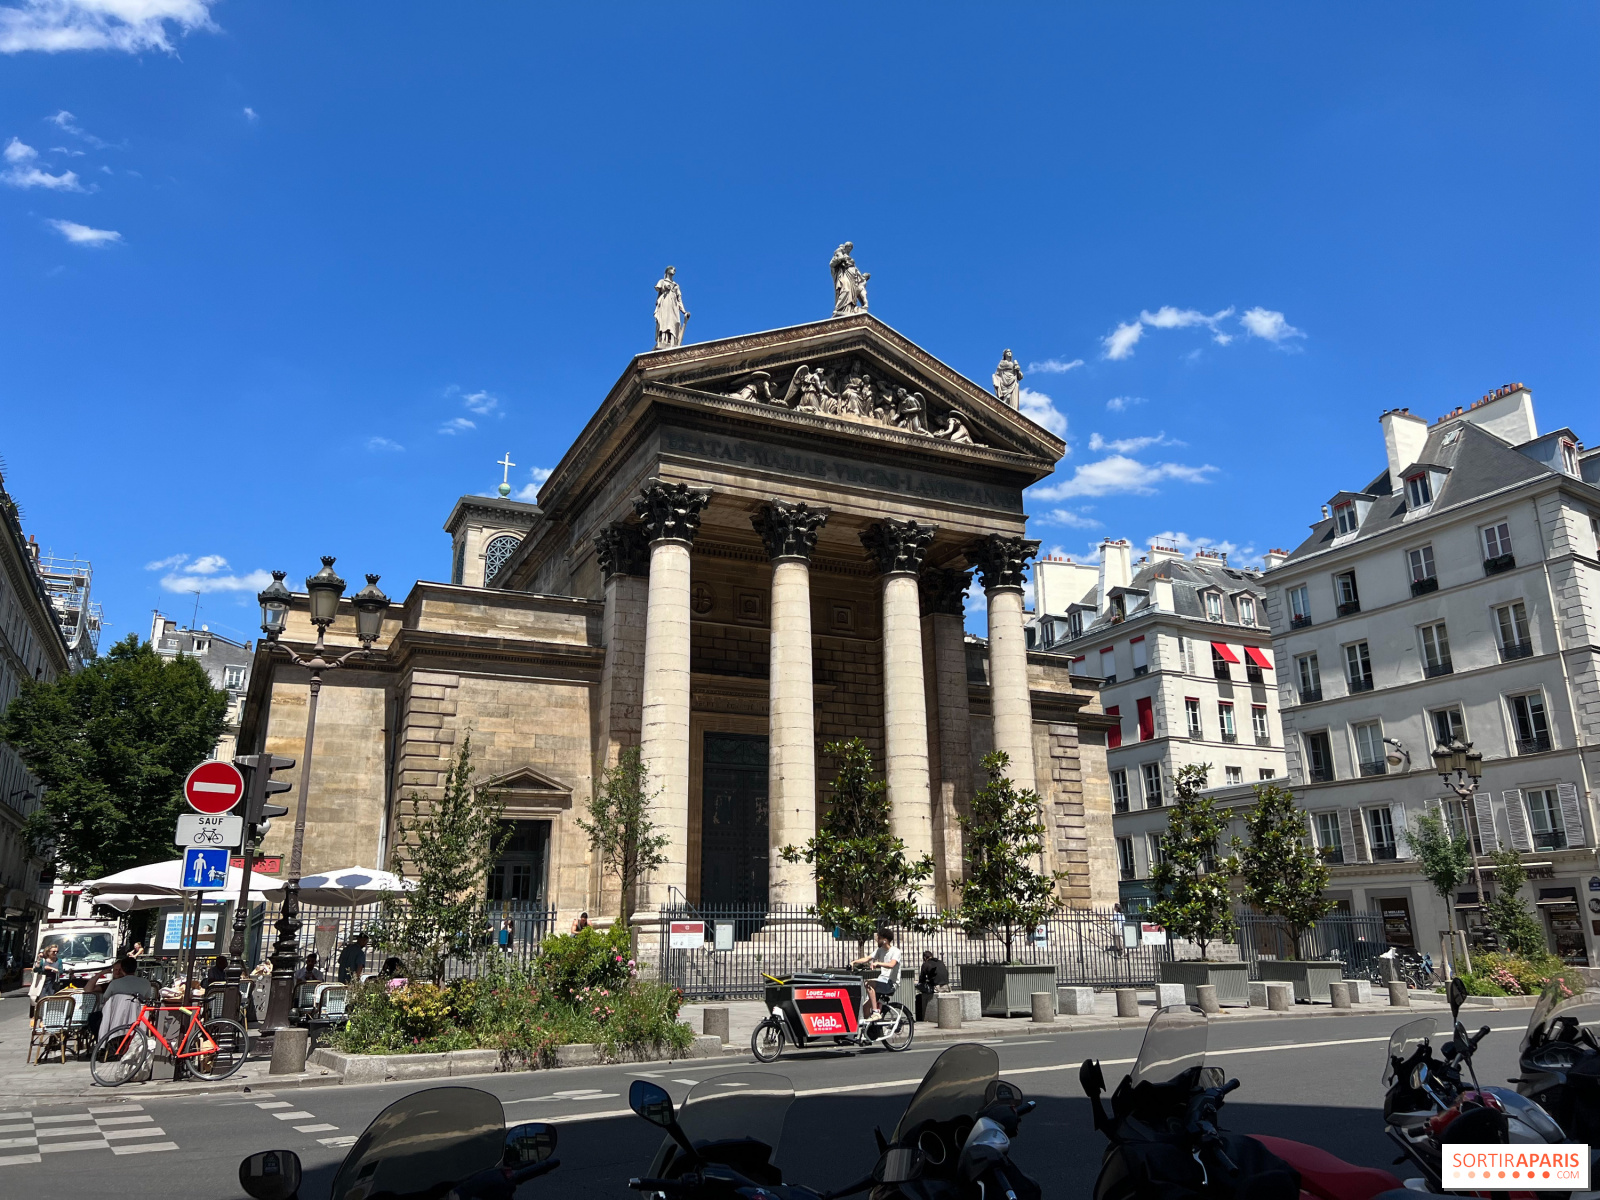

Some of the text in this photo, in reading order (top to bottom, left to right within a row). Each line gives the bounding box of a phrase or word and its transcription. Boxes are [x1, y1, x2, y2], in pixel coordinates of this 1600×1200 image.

[667, 433, 747, 463] BEATAE
[753, 445, 827, 477] MARIAE
[832, 461, 900, 490] VIRGINI
[198, 817, 224, 826] SAUF
